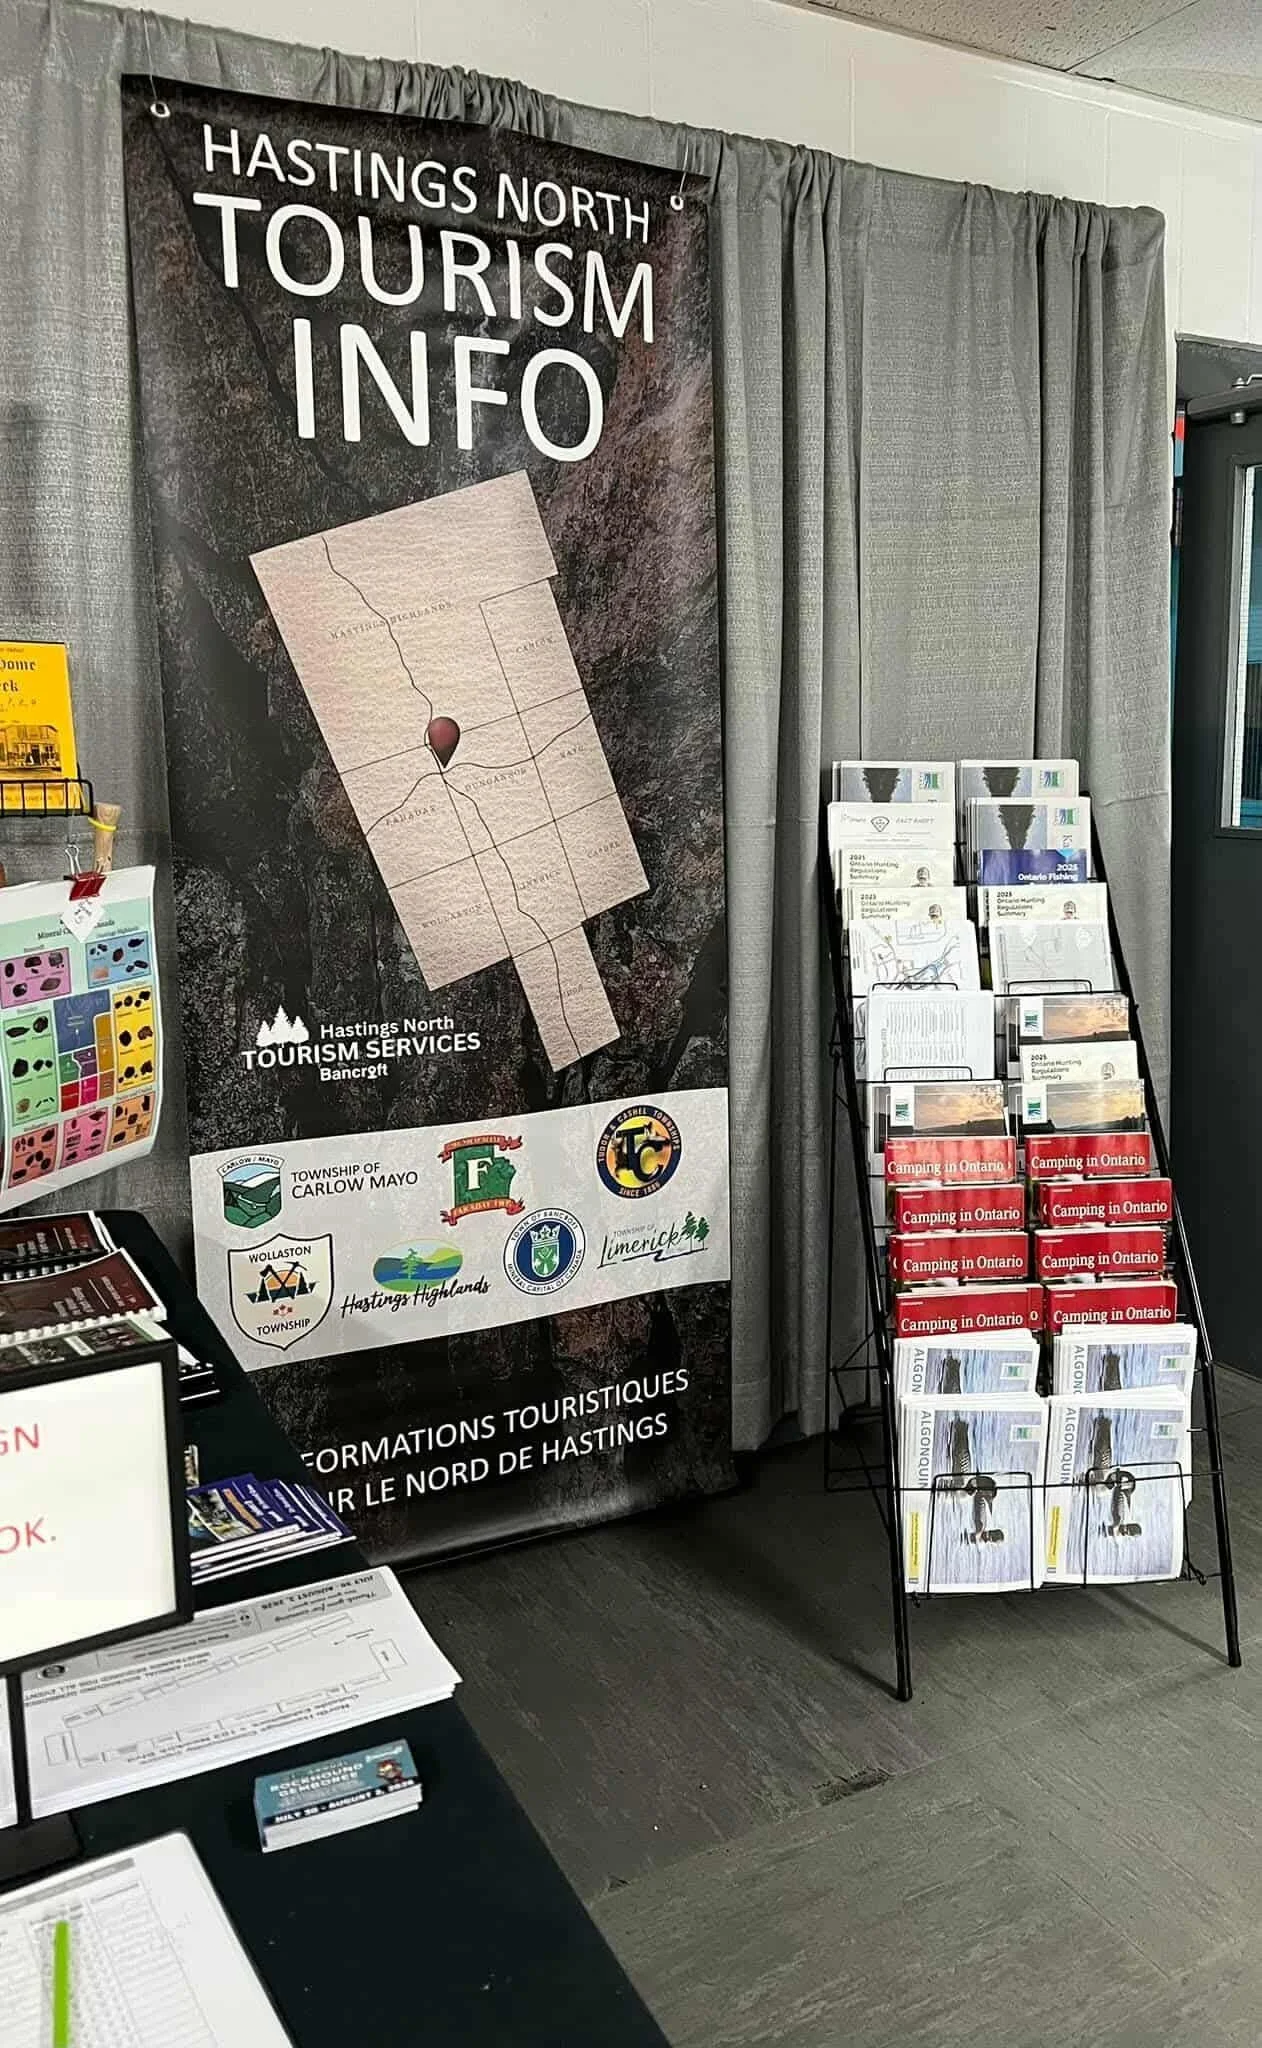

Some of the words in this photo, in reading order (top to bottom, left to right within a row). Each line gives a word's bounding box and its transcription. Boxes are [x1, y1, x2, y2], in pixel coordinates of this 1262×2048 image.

[202, 123, 478, 215] HASTINGS
[496, 176, 650, 244] NORTH
[193, 192, 654, 344] TOURISM
[293, 318, 604, 462] INFO
[1018, 873, 1047, 881] Ontario
[1049, 874, 1078, 882] Fishing
[320, 1021, 399, 1039] Hastings
[404, 1016, 454, 1032] North
[241, 1042, 359, 1070] TOURISM
[366, 1032, 481, 1059] SERVICES
[320, 1063, 388, 1081] Bancroft
[222, 1157, 252, 1173] CARLOW
[258, 1156, 279, 1166] MAYO
[888, 1160, 941, 1176] Camping
[944, 1160, 957, 1172] in
[959, 1160, 1004, 1172] Ontario
[1031, 1155, 1084, 1171] Camping
[1086, 1154, 1098, 1167] in
[1100, 1153, 1146, 1166] Ontario
[291, 1165, 360, 1183] TOWNSHIP
[363, 1162, 381, 1174] OF
[466, 1157, 493, 1190] F
[291, 1177, 365, 1199] CARLOW
[370, 1171, 418, 1189] MAYO
[902, 1209, 956, 1224] Camping
[960, 1208, 972, 1220] in
[974, 1206, 1020, 1221] Ontario
[1052, 1203, 1105, 1219] Camping
[1109, 1202, 1120, 1214] in
[1123, 1200, 1168, 1213] Ontario
[511, 1221, 529, 1240] TOWN
[613, 1225, 646, 1238] TOWNSHIP
[248, 1245, 312, 1264] WOLLASTON
[597, 1222, 682, 1269] Limerick
[904, 1257, 958, 1273] Camping
[961, 1256, 974, 1269] in
[977, 1254, 1024, 1268] Ontario
[1042, 1254, 1095, 1269] Camping
[1098, 1252, 1110, 1265] in
[1112, 1250, 1159, 1264] Ontario
[340, 1291, 410, 1319] Hastings
[413, 1274, 491, 1307] Highlands
[901, 1316, 958, 1332] Camping
[961, 1315, 973, 1328] in
[976, 1312, 1023, 1327] Ontario
[1054, 1309, 1108, 1324] Camping
[1111, 1307, 1123, 1320] in
[1126, 1305, 1171, 1320] Ontario
[256, 1318, 310, 1336] TOWNSHIP
[502, 1368, 689, 1434] TOURISTIQUES
[918, 1410, 932, 1489] ALGONQUIN
[365, 1478, 396, 1508] LE
[406, 1457, 489, 1497] NORD
[499, 1446, 534, 1476] DE
[542, 1412, 668, 1463] HASTINGS
